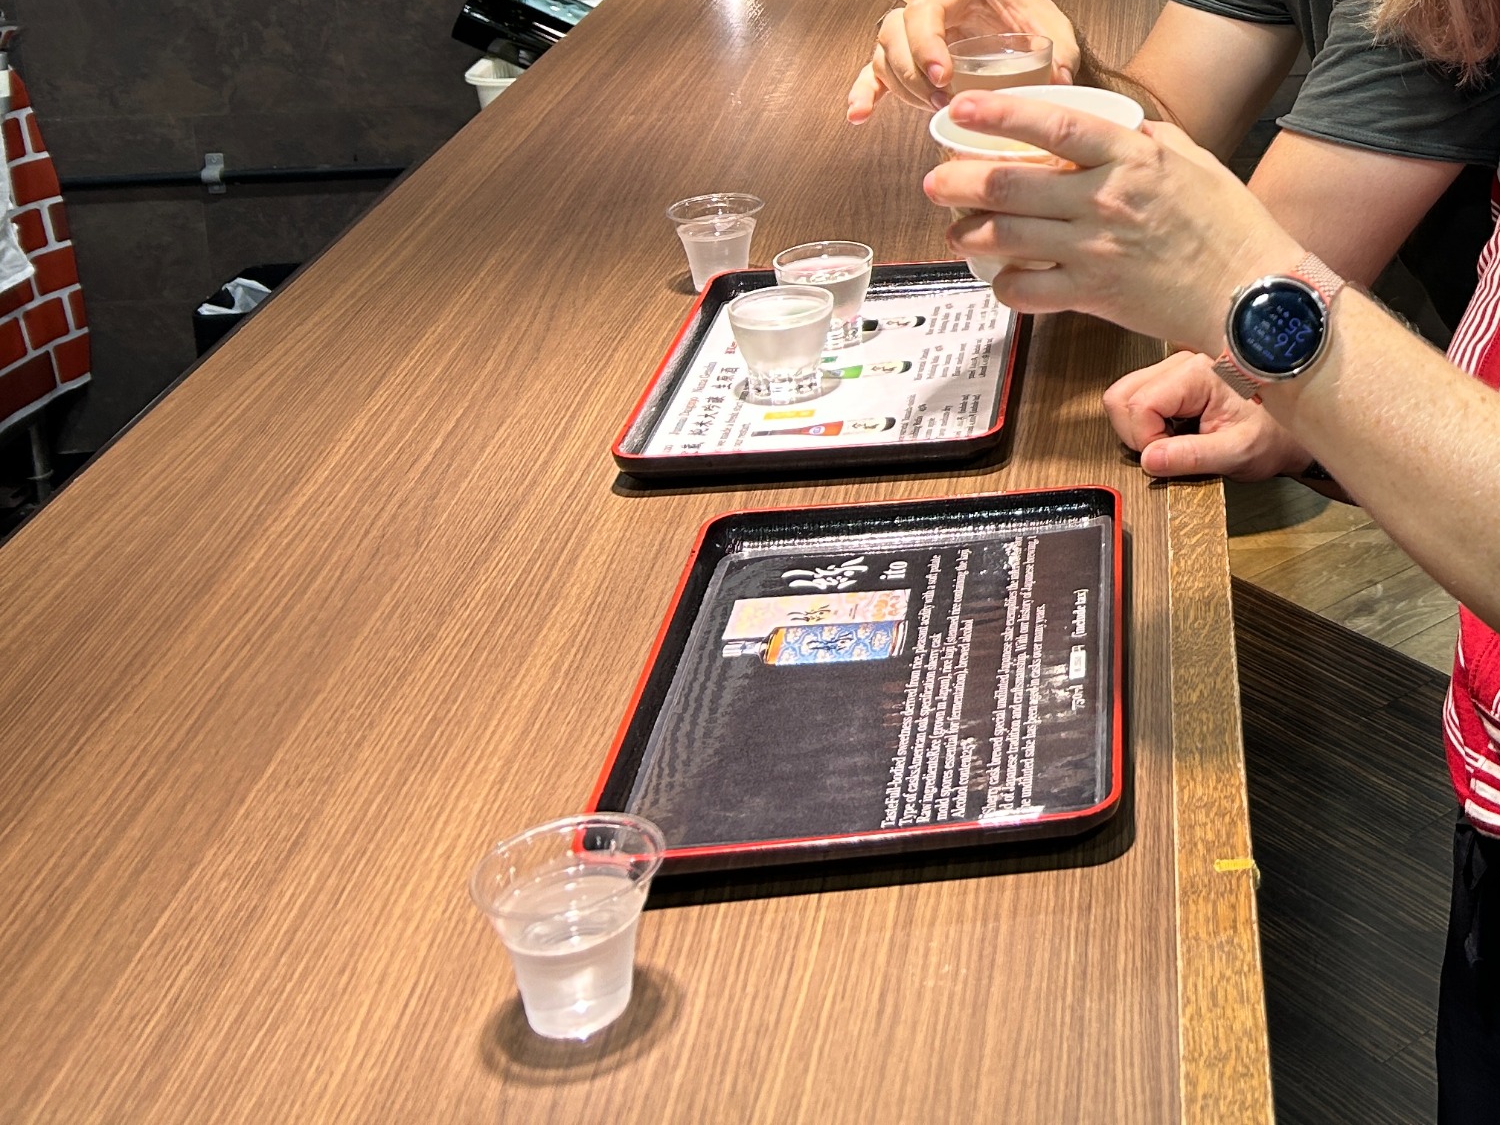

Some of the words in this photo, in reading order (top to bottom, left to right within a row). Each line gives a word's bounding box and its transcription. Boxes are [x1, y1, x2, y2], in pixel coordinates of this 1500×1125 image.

[691, 396, 724, 436] 純米大吟醸
[712, 367, 739, 390] 生原酒
[879, 560, 909, 580] ito
[927, 554, 941, 573] palate
[952, 570, 969, 603] containing
[1021, 564, 1035, 591] Japanese
[921, 589, 935, 603] with
[1004, 590, 1019, 626] exemplifies
[1073, 588, 1089, 605] tax)
[918, 604, 935, 626] acidity
[1017, 599, 1034, 621] history
[1036, 603, 1047, 623] years.
[1071, 605, 1087, 638] (include
[912, 626, 929, 653] pleasant
[929, 632, 942, 648] cask
[943, 615, 960, 645] (steamed
[959, 619, 974, 643] alcohol
[1000, 626, 1015, 641] sake
[1015, 633, 1029, 651] With
[1034, 623, 1047, 642] many
[908, 653, 926, 669] rice,
[924, 648, 942, 671] sherry
[955, 642, 971, 668] brewed
[997, 642, 1013, 673] Japanese
[1032, 643, 1043, 658] over
[905, 669, 921, 688] from
[1011, 652, 1029, 703] craftsmanship.
[1028, 658, 1042, 678] casks
[919, 671, 936, 716] specification
[935, 673, 953, 701] Japan),
[947, 668, 968, 720] fermentation),
[994, 674, 1010, 709] undiluted
[900, 688, 918, 716] derived
[1009, 703, 1022, 719] and
[1023, 705, 1038, 724] been
[895, 716, 913, 755] sweetness
[929, 710, 946, 738] (grown
[991, 709, 1007, 736] special
[1005, 719, 1021, 754] tradition
[1021, 739, 1036, 757] sake
[944, 734, 958, 769] essential
[987, 736, 1003, 766] brewed
[940, 769, 954, 797] spores
[984, 765, 1000, 785] cask
[1001, 754, 1018, 791] Japanese
[1018, 758, 1034, 798] undiluted
[898, 803, 917, 825] Type
[915, 803, 932, 823] Raw
[934, 797, 950, 820] mold
[951, 785, 968, 818] Alcohol
